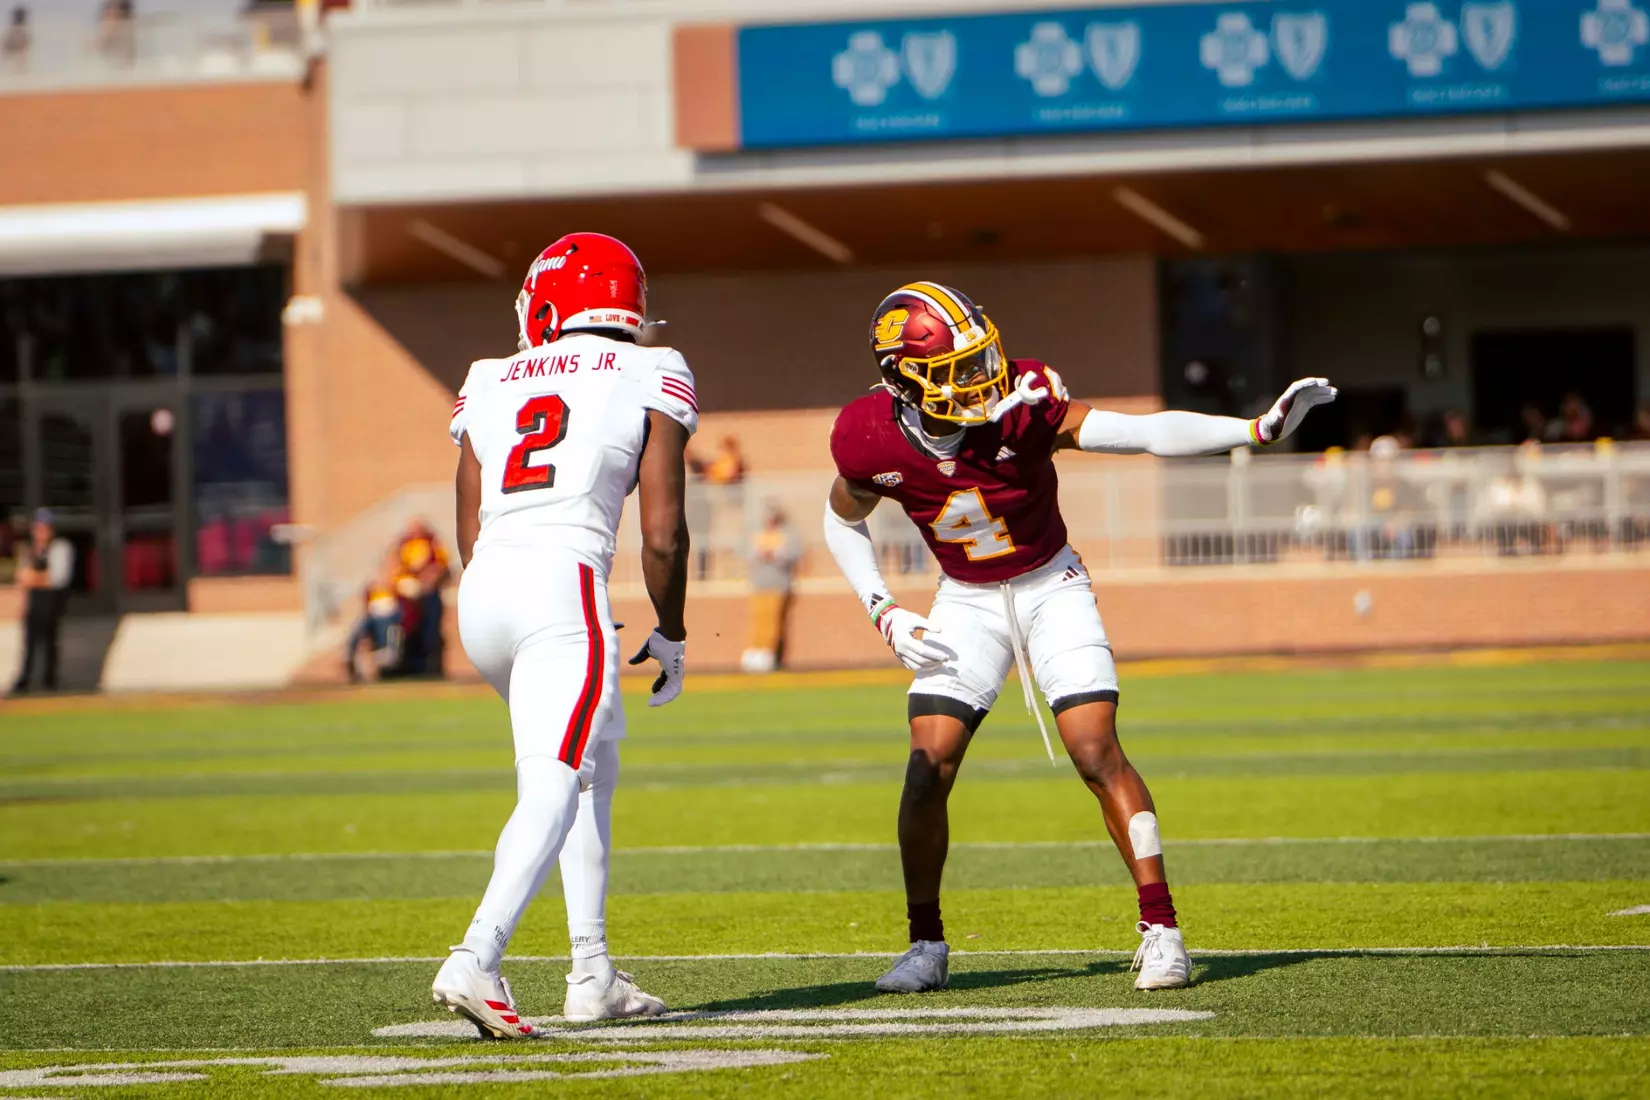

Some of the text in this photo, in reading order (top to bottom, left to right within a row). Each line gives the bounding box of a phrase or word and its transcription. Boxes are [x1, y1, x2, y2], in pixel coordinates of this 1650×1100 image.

[500, 352, 622, 382] JENKINS JR.
[500, 393, 571, 495] 2
[927, 486, 1017, 561] 4
